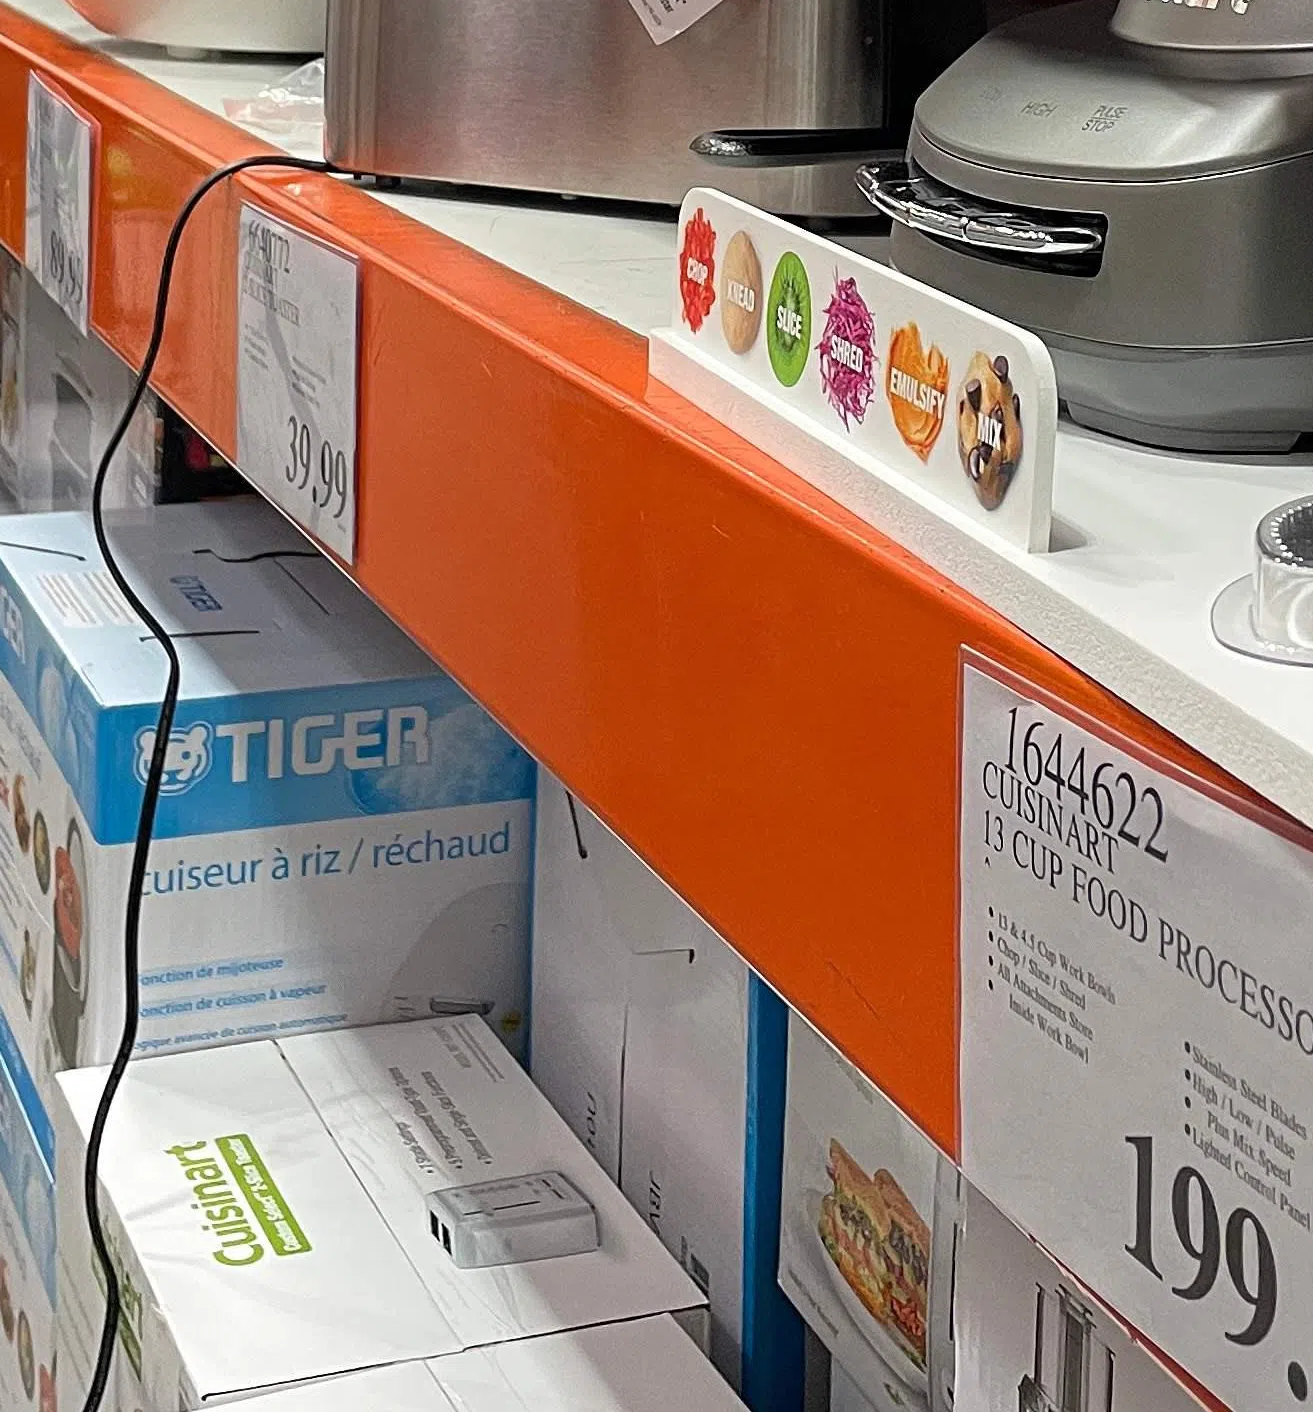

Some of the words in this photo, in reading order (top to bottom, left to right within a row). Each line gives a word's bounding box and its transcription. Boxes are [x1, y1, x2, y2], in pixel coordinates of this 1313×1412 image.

[1021, 100, 1058, 117] HIGH
[1081, 119, 1115, 132] STOP
[687, 258, 708, 285] CHOP
[727, 279, 755, 314] KNEAD
[776, 309, 802, 340] SLICE
[831, 336, 864, 373] SHRED
[890, 371, 946, 421] EMULSIFY
[977, 415, 1003, 450] MIX
[286, 416, 348, 519] 39.99
[213, 705, 432, 784] TIGER
[983, 761, 1120, 875] CUISINART
[1005, 707, 1168, 863] 1644622
[272, 847, 289, 880] à
[301, 843, 342, 878] riz
[348, 837, 364, 875] /
[373, 820, 510, 869] réchaud
[985, 810, 1004, 852] 13
[1013, 830, 1063, 889] CUP
[1072, 863, 1148, 944] FOOD
[140, 968, 194, 987] onction
[196, 966, 213, 979] de
[216, 959, 285, 977] mijoteuse
[997, 936, 1020, 967] Chop
[1028, 958, 1051, 986] Slice
[1059, 979, 1086, 1011] Shred
[1010, 921, 1020, 940] &
[1038, 940, 1057, 968] Cup
[1059, 952, 1086, 985] Work
[1087, 971, 1116, 1006] Bowls
[140, 999, 194, 1019] onction
[196, 997, 213, 1011] de
[216, 992, 267, 1008] cuisson
[997, 962, 1011, 984] All
[1013, 973, 1067, 1023] Attachments
[1069, 1010, 1094, 1041] Store
[1009, 992, 1035, 1025] Inside
[1037, 1013, 1063, 1046] Work
[1064, 1033, 1089, 1064] Bowl
[1192, 1045, 1237, 1091] Stainless
[1240, 1078, 1267, 1112] Steel
[1270, 1098, 1308, 1141] Blades
[1192, 1072, 1218, 1106] High
[1229, 1097, 1253, 1129] Low
[1265, 1124, 1296, 1161] Pulse
[1192, 1126, 1232, 1171] Lighted
[1235, 1159, 1277, 1205] Control
[1280, 1192, 1311, 1233] Panel
[1207, 1110, 1230, 1142] Plus
[1233, 1128, 1256, 1161] Mix
[1258, 1148, 1292, 1188] Speed
[163, 1140, 265, 1266] Cuisinart
